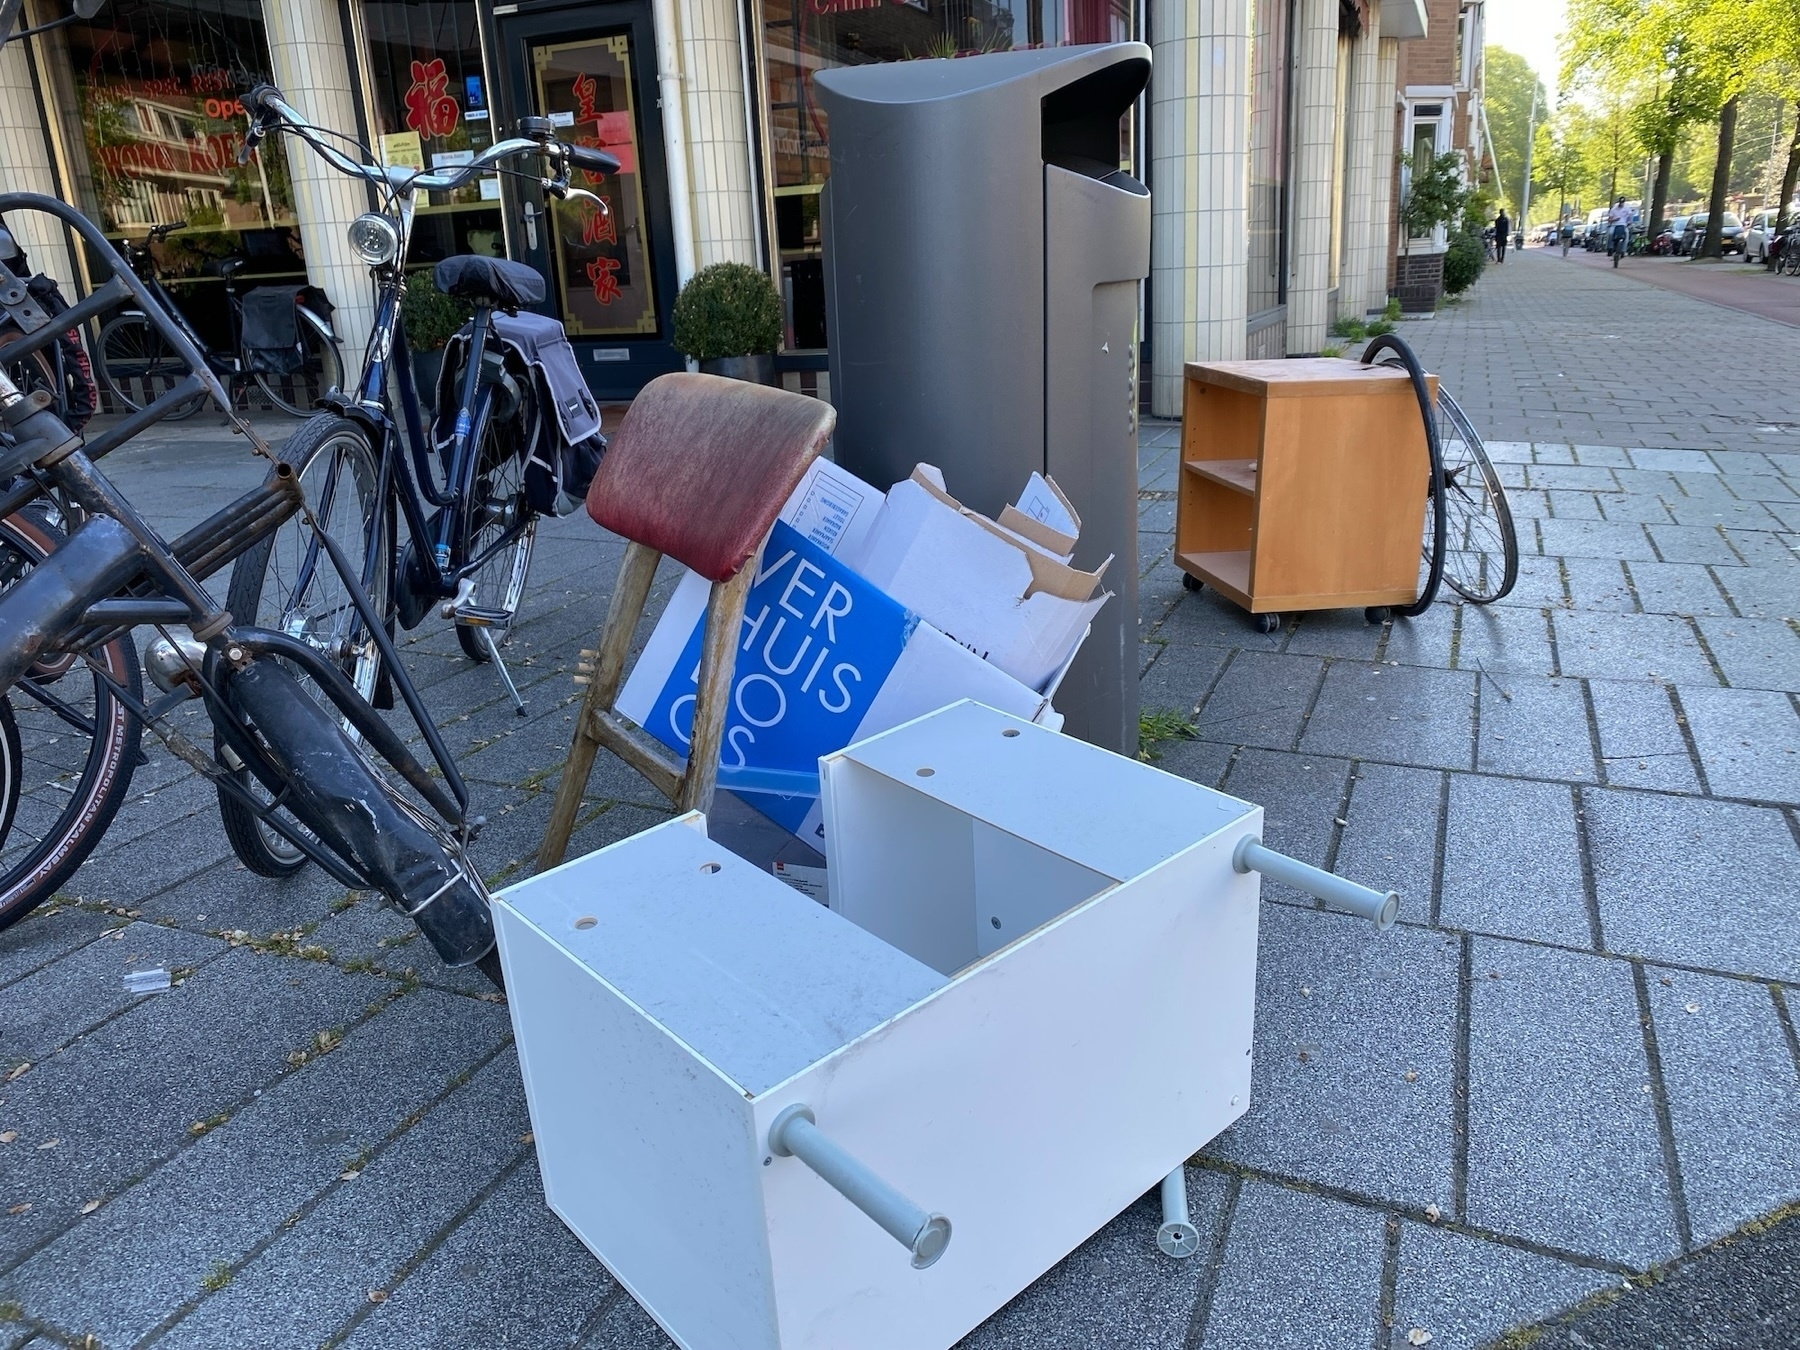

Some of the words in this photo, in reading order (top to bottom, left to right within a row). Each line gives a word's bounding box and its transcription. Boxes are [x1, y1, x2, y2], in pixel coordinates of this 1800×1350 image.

[205, 97, 246, 120] Ope
[404, 58, 460, 141] 福
[812, 528, 834, 544] SLAAPKAMER
[822, 516, 841, 530] BADKAMER
[823, 526, 838, 537] KEUKEN
[832, 513, 846, 524] TOILET
[752, 550, 853, 644] VER
[742, 604, 862, 714] HUIS
[83, 724, 124, 825] METROPOLITAN
[38, 820, 88, 878] PALMBAY
